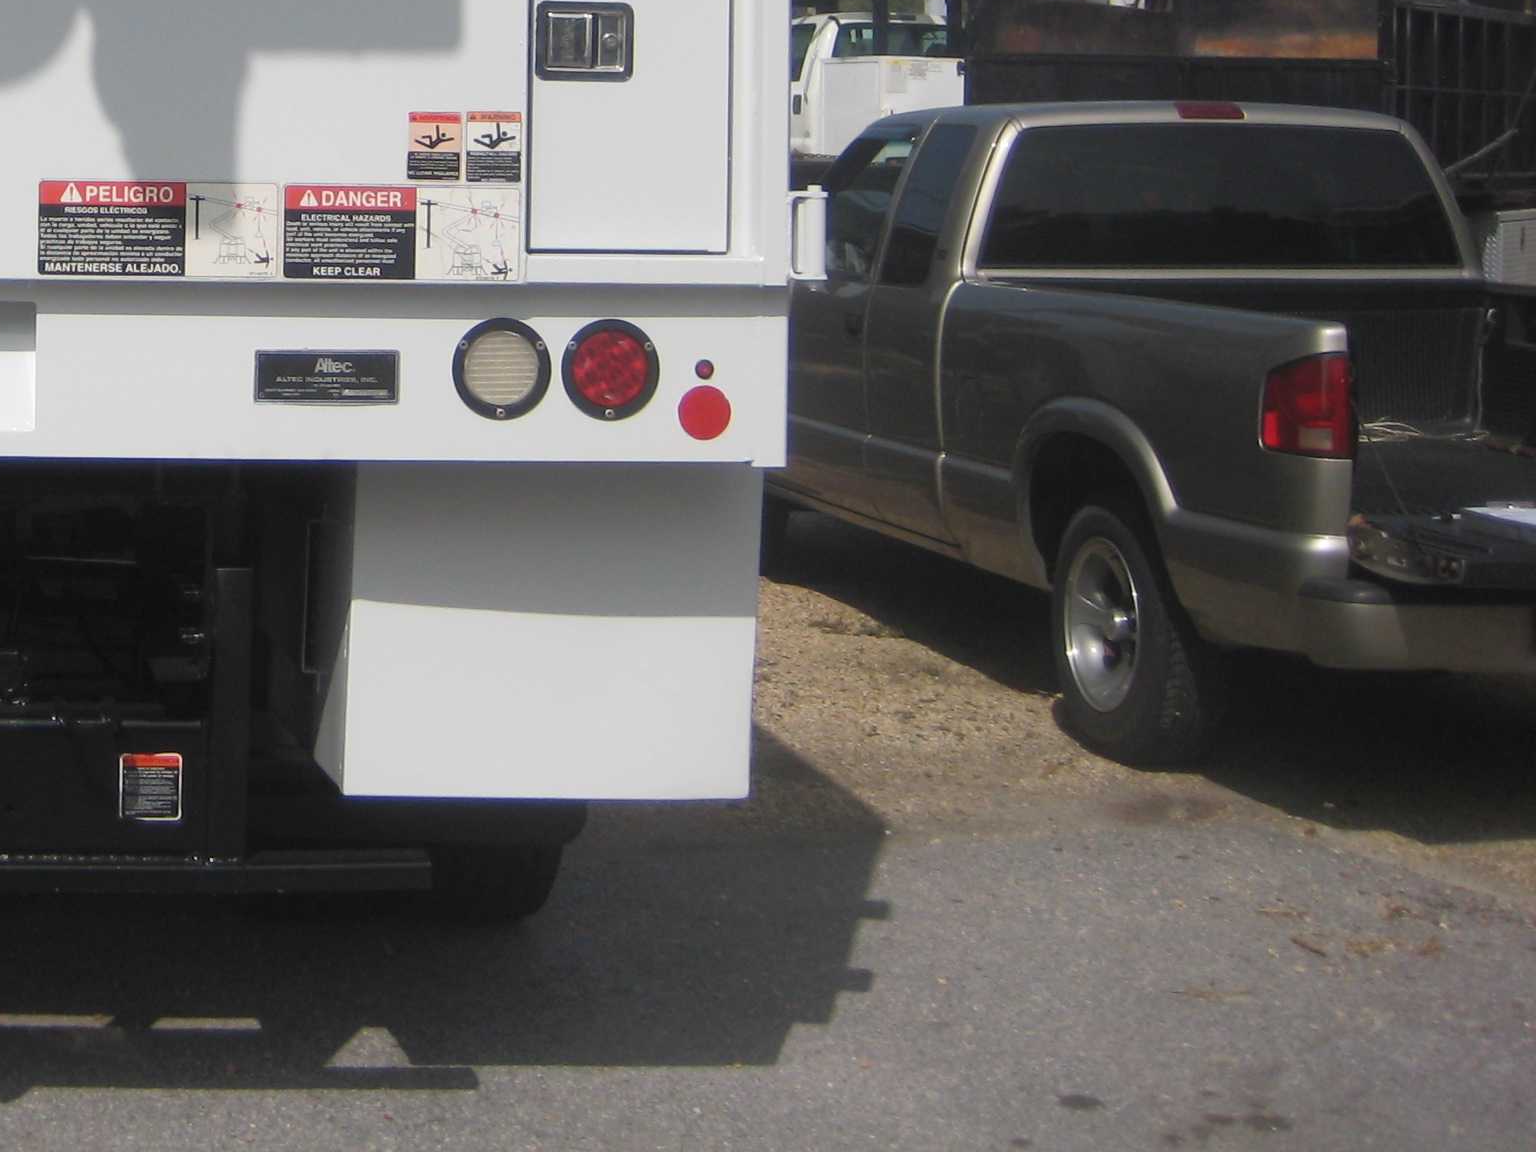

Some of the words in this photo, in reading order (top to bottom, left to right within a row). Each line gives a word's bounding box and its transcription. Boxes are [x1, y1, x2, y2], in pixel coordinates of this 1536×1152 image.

[85, 185, 174, 203] PELIGRO
[321, 191, 402, 208] DANGER
[301, 214, 351, 222] ELECTRICAL
[352, 215, 392, 223] HAZARDS
[44, 263, 123, 273] MANTENERSE
[125, 264, 182, 274] ALEJADO.
[312, 267, 341, 277] KEEP
[343, 267, 381, 277] CLEAR
[314, 357, 353, 373] Altec
